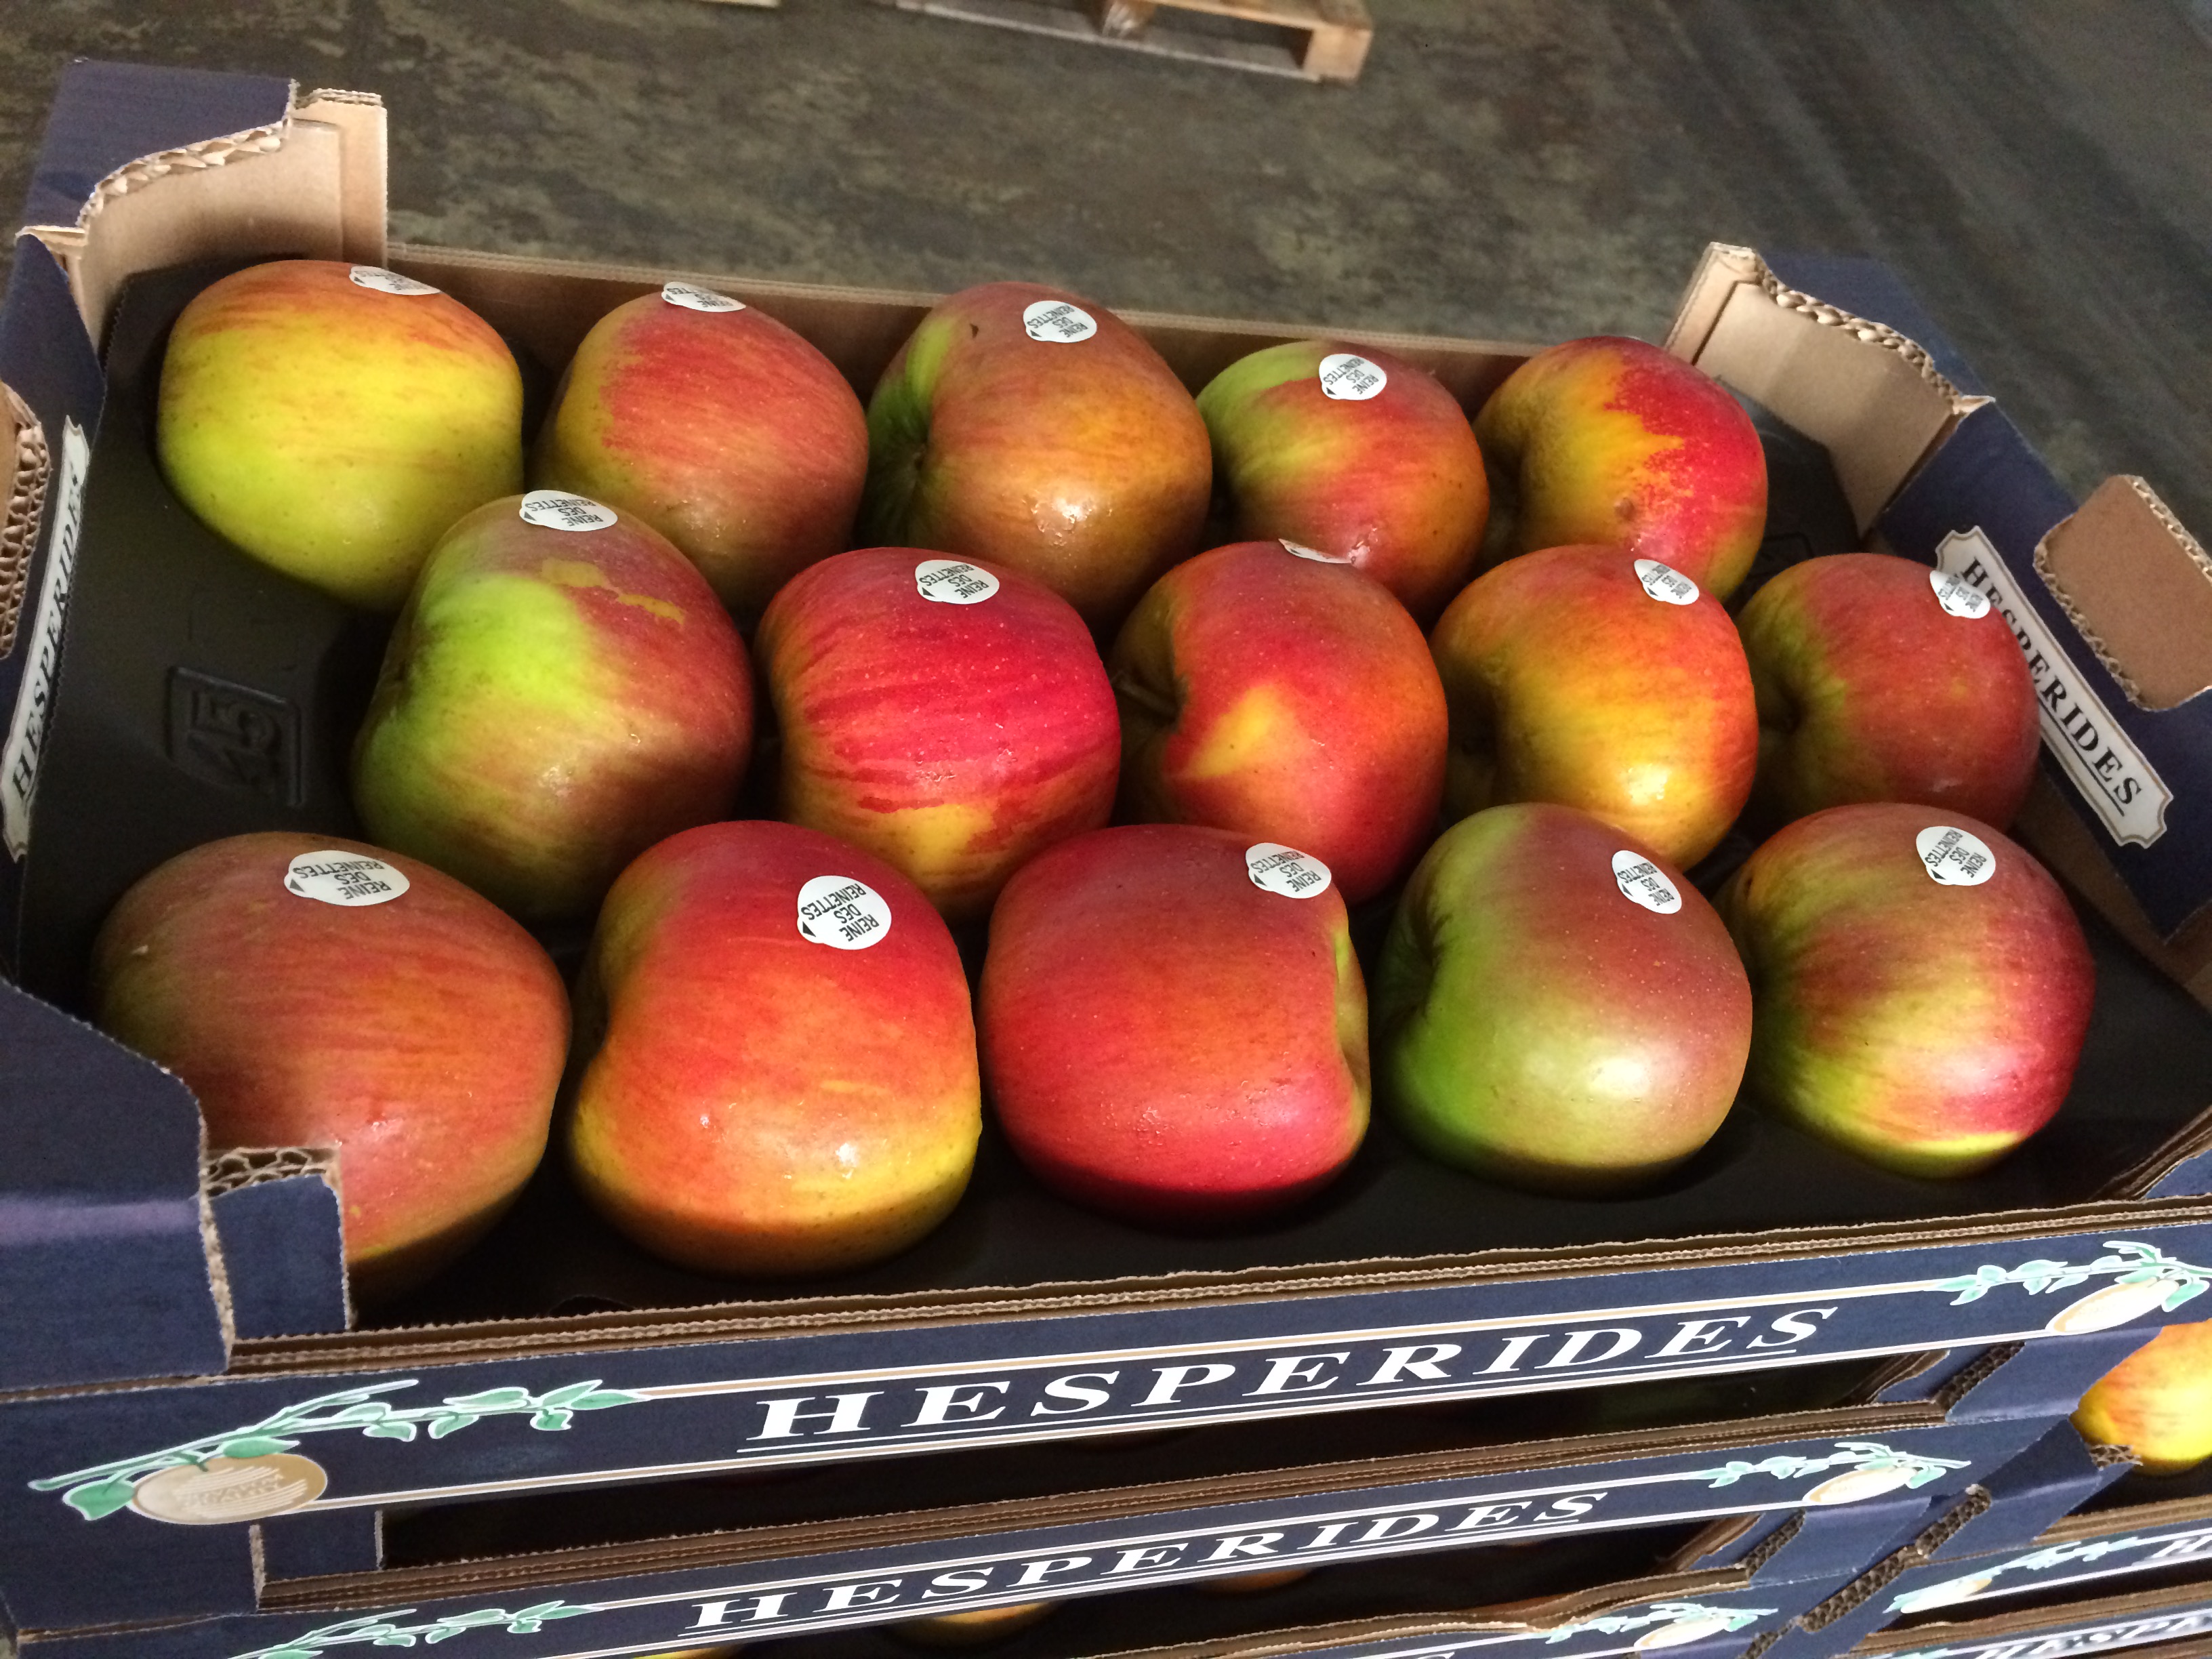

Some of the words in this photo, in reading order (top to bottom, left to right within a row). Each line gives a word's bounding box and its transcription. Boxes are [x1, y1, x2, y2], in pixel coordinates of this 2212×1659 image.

[1027, 305, 1075, 329] REINETTES
[1052, 316, 1073, 329] DES
[1059, 322, 1088, 337] REINE
[1323, 356, 1364, 385] REINETTES
[1346, 369, 1365, 383] DES
[1352, 374, 1379, 394] REINE
[525, 499, 596, 512] REINETTES
[558, 507, 586, 516] DES
[562, 514, 603, 527] REINE
[919, 564, 975, 586] REINETTES
[947, 574, 972, 588] DES
[1662, 575, 1679, 588] DES
[954, 579, 989, 598] REINE
[1925, 829, 1963, 867] REINETTES
[1949, 846, 1970, 865] DES
[293, 861, 385, 879] REINETTES
[1250, 850, 1305, 873] REINETTES
[1279, 861, 1305, 878] DES
[1960, 852, 1987, 878] REINE
[333, 871, 372, 885] DES
[1286, 870, 1322, 893] REINE
[1617, 862, 1658, 884] REINETTES
[336, 880, 392, 899] REINE
[1640, 876, 1660, 892] DES
[800, 883, 867, 920] REINETTES
[1648, 888, 1675, 906] REINE
[833, 903, 862, 924] DES
[838, 914, 880, 941] REINE
[745, 1306, 1839, 1441] HESPERIDES
[684, 1492, 1608, 1630] HESPERIDES
